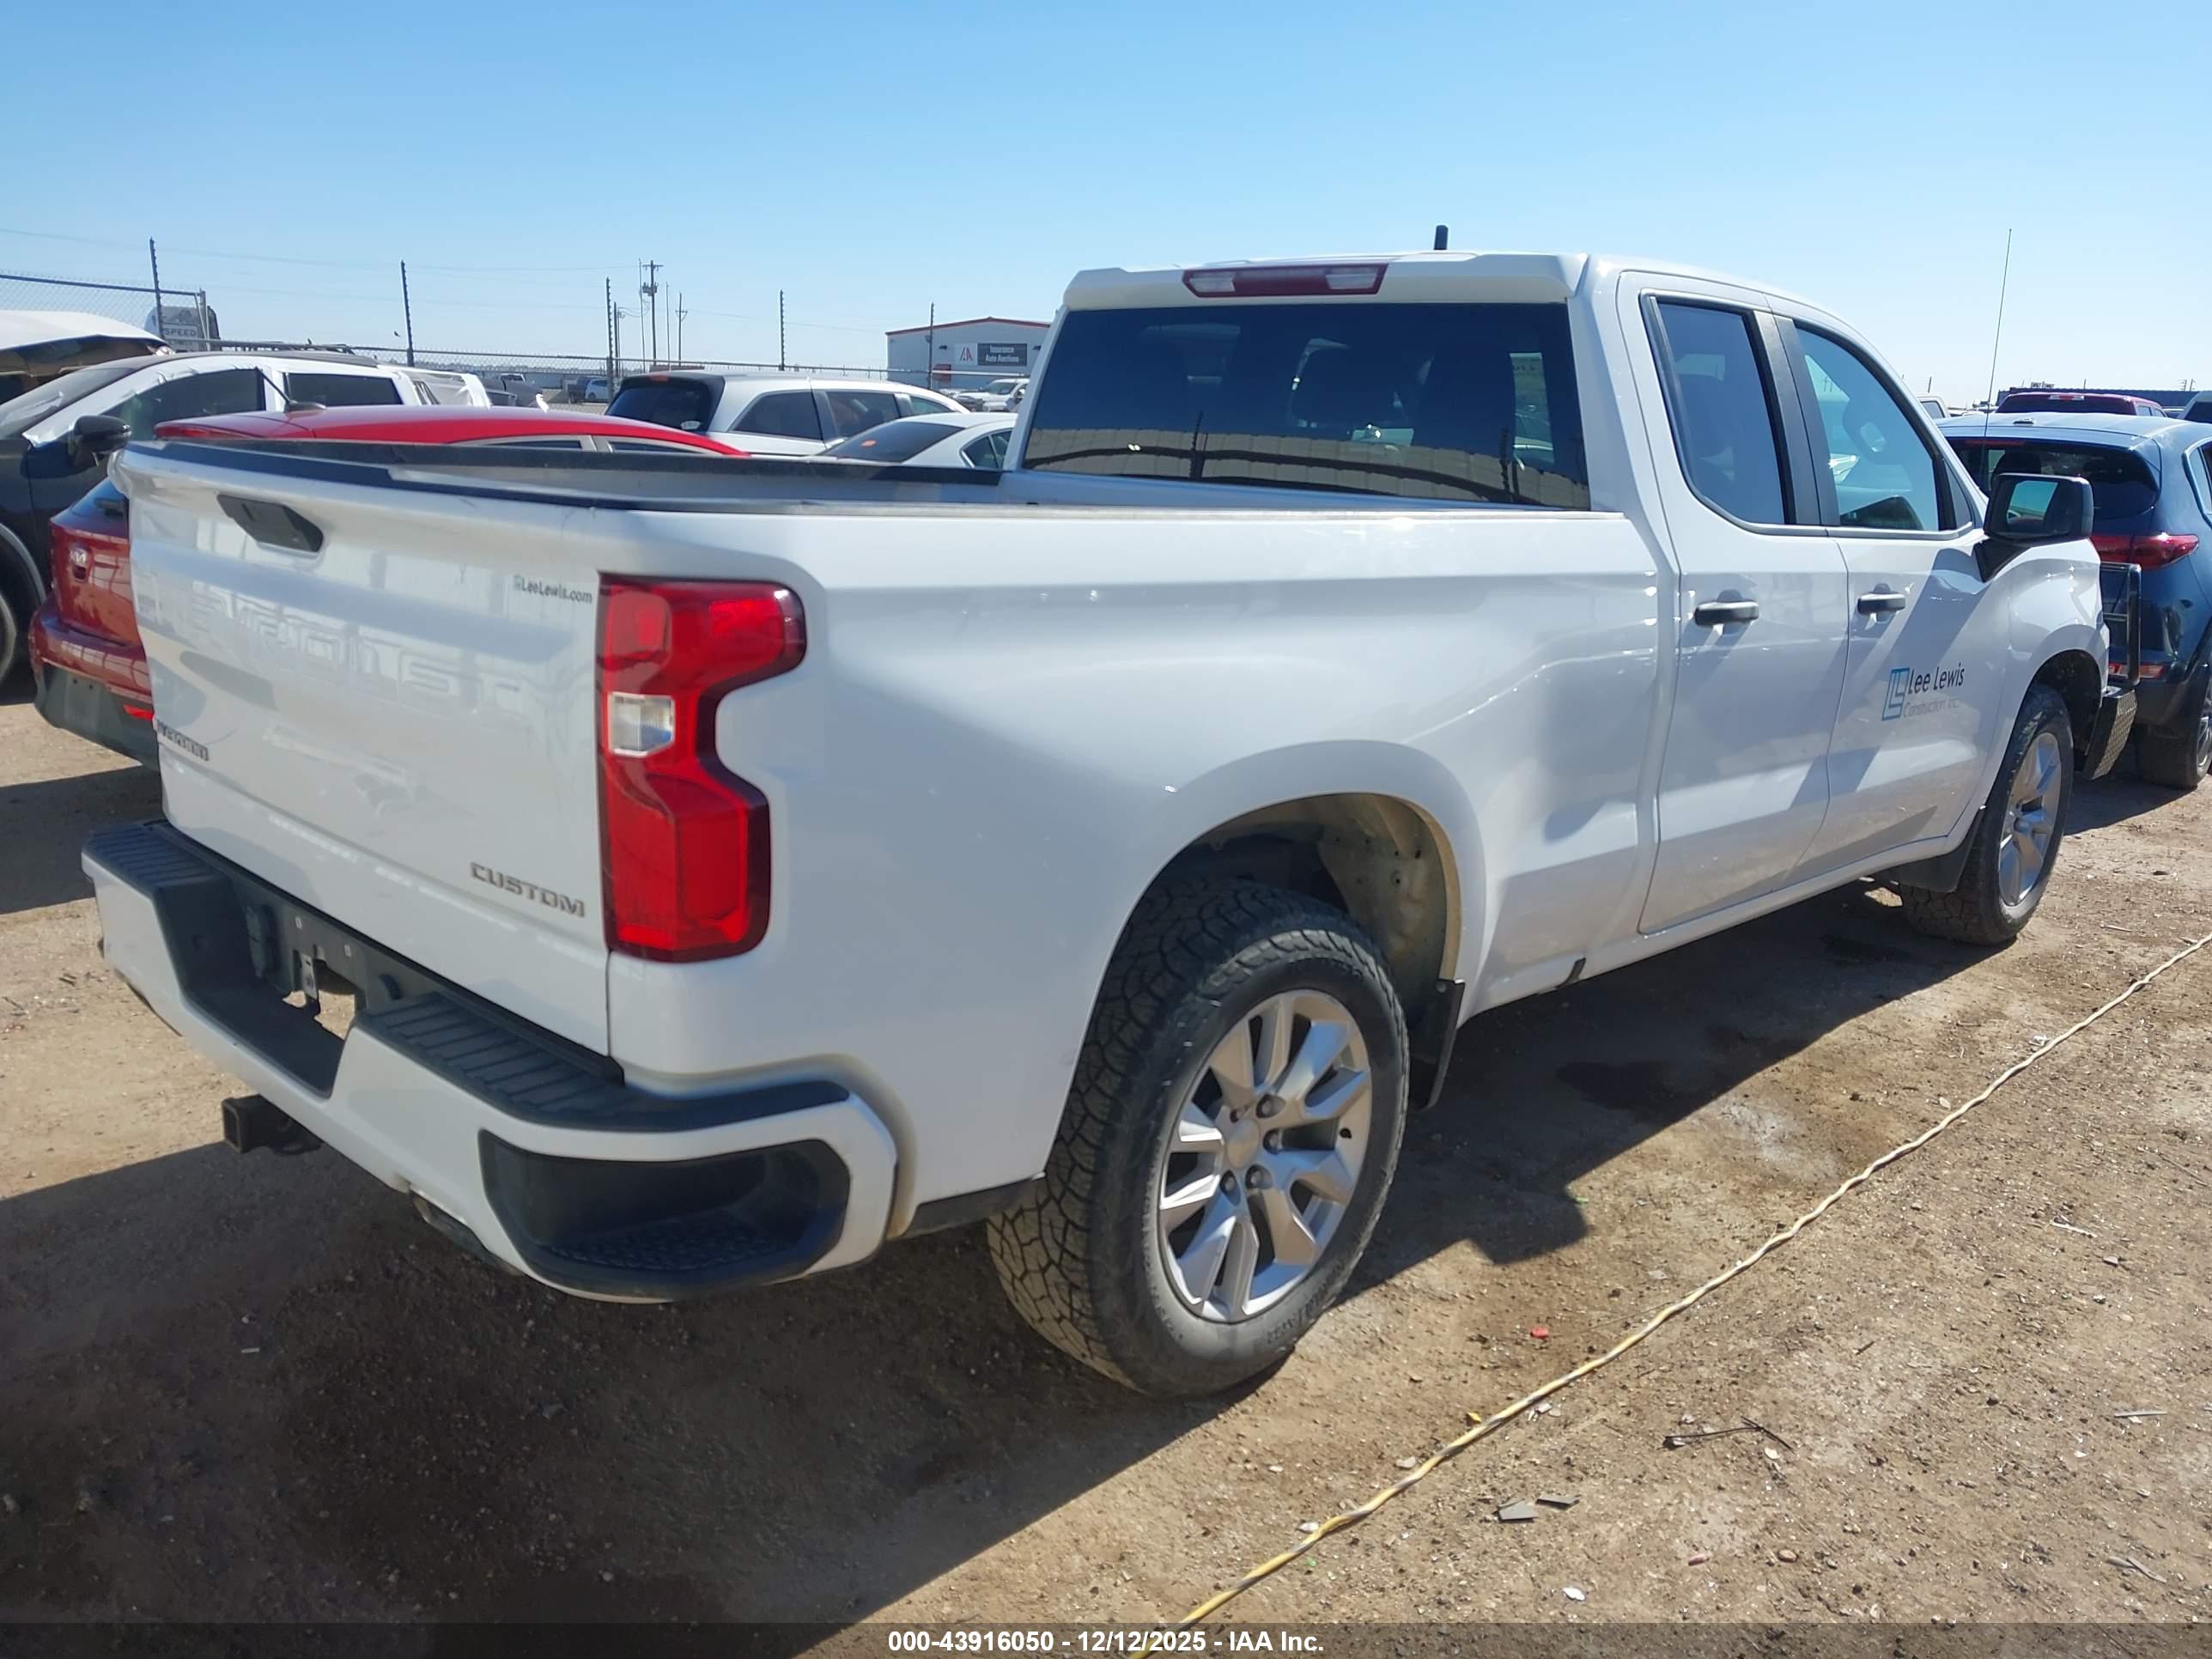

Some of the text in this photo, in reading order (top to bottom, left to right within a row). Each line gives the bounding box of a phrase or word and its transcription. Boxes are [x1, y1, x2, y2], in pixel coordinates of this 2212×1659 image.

[521, 576, 592, 605] LeeLewis.com
[1908, 661, 1965, 695] Lee Lewis
[470, 861, 586, 918] CUSTOM
